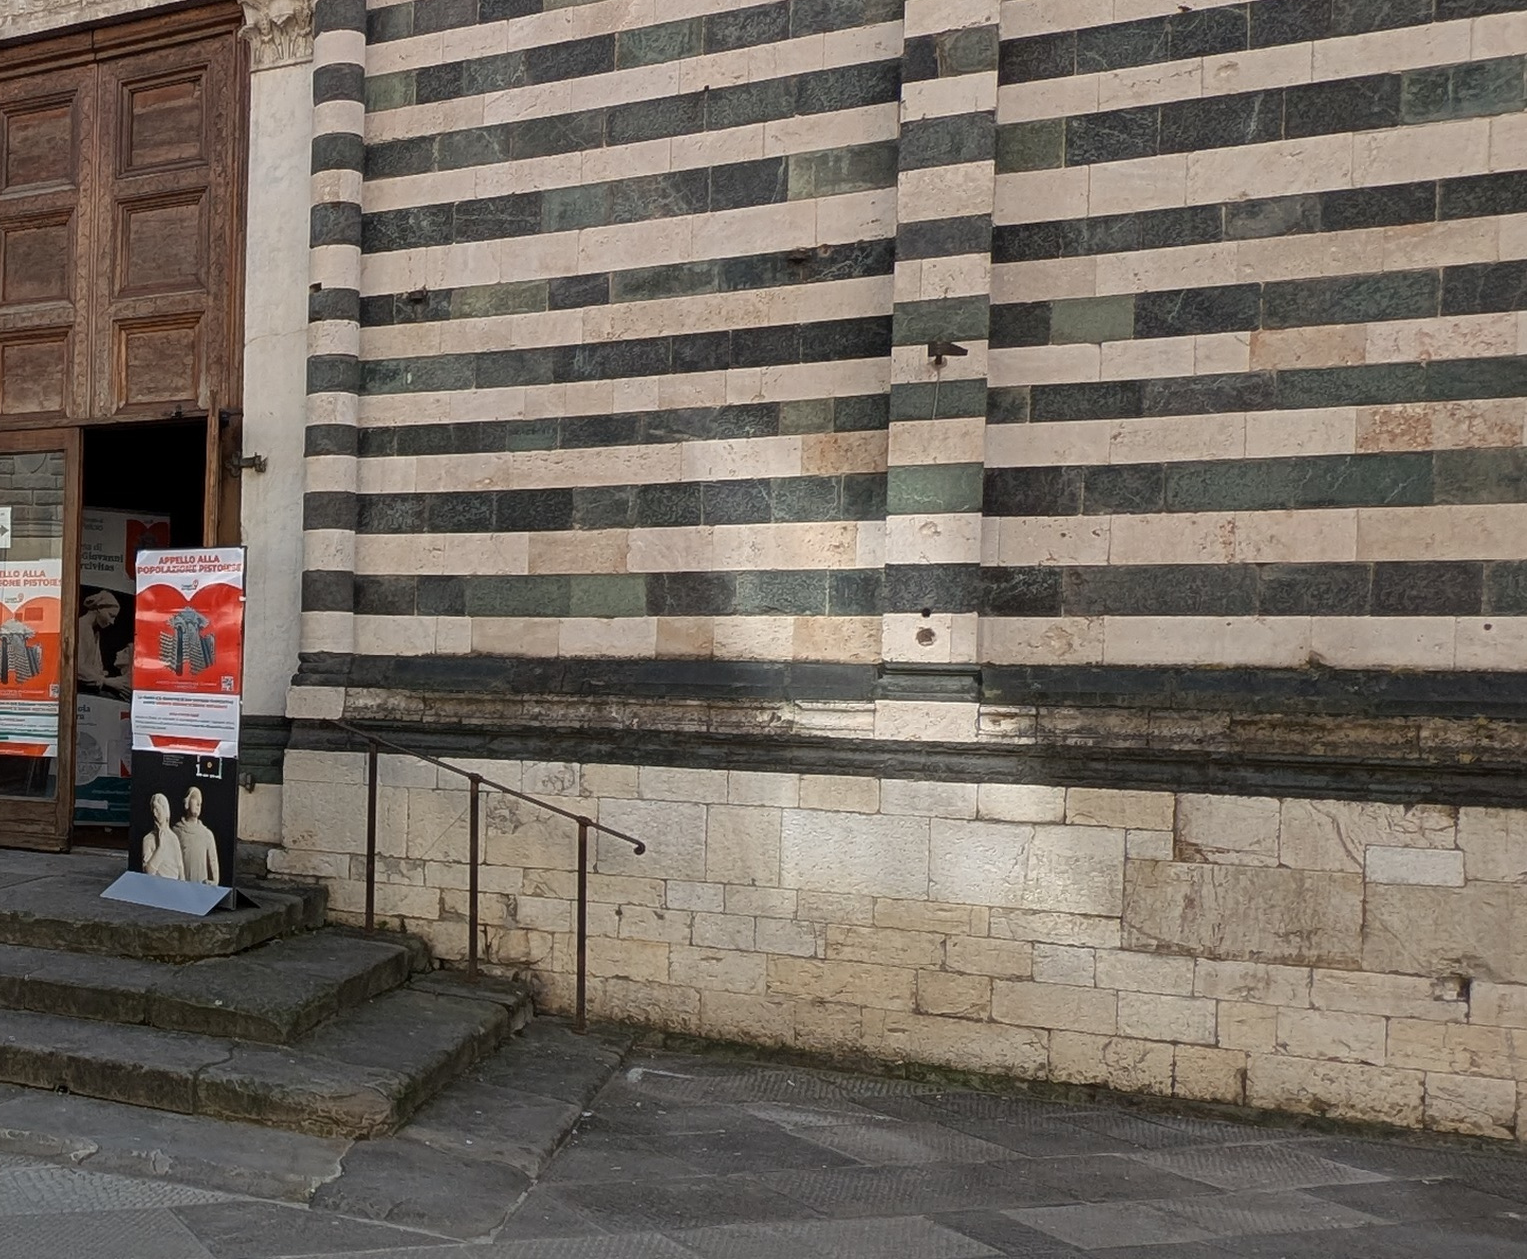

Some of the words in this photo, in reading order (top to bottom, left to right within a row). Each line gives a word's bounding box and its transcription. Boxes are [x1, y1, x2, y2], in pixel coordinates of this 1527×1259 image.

[82, 552, 124, 563] Giovanni
[159, 556, 195, 565] APPELLO
[197, 555, 220, 563] ALLA
[22, 569, 46, 578] ALLA
[137, 565, 197, 574] POPOLAZIONE
